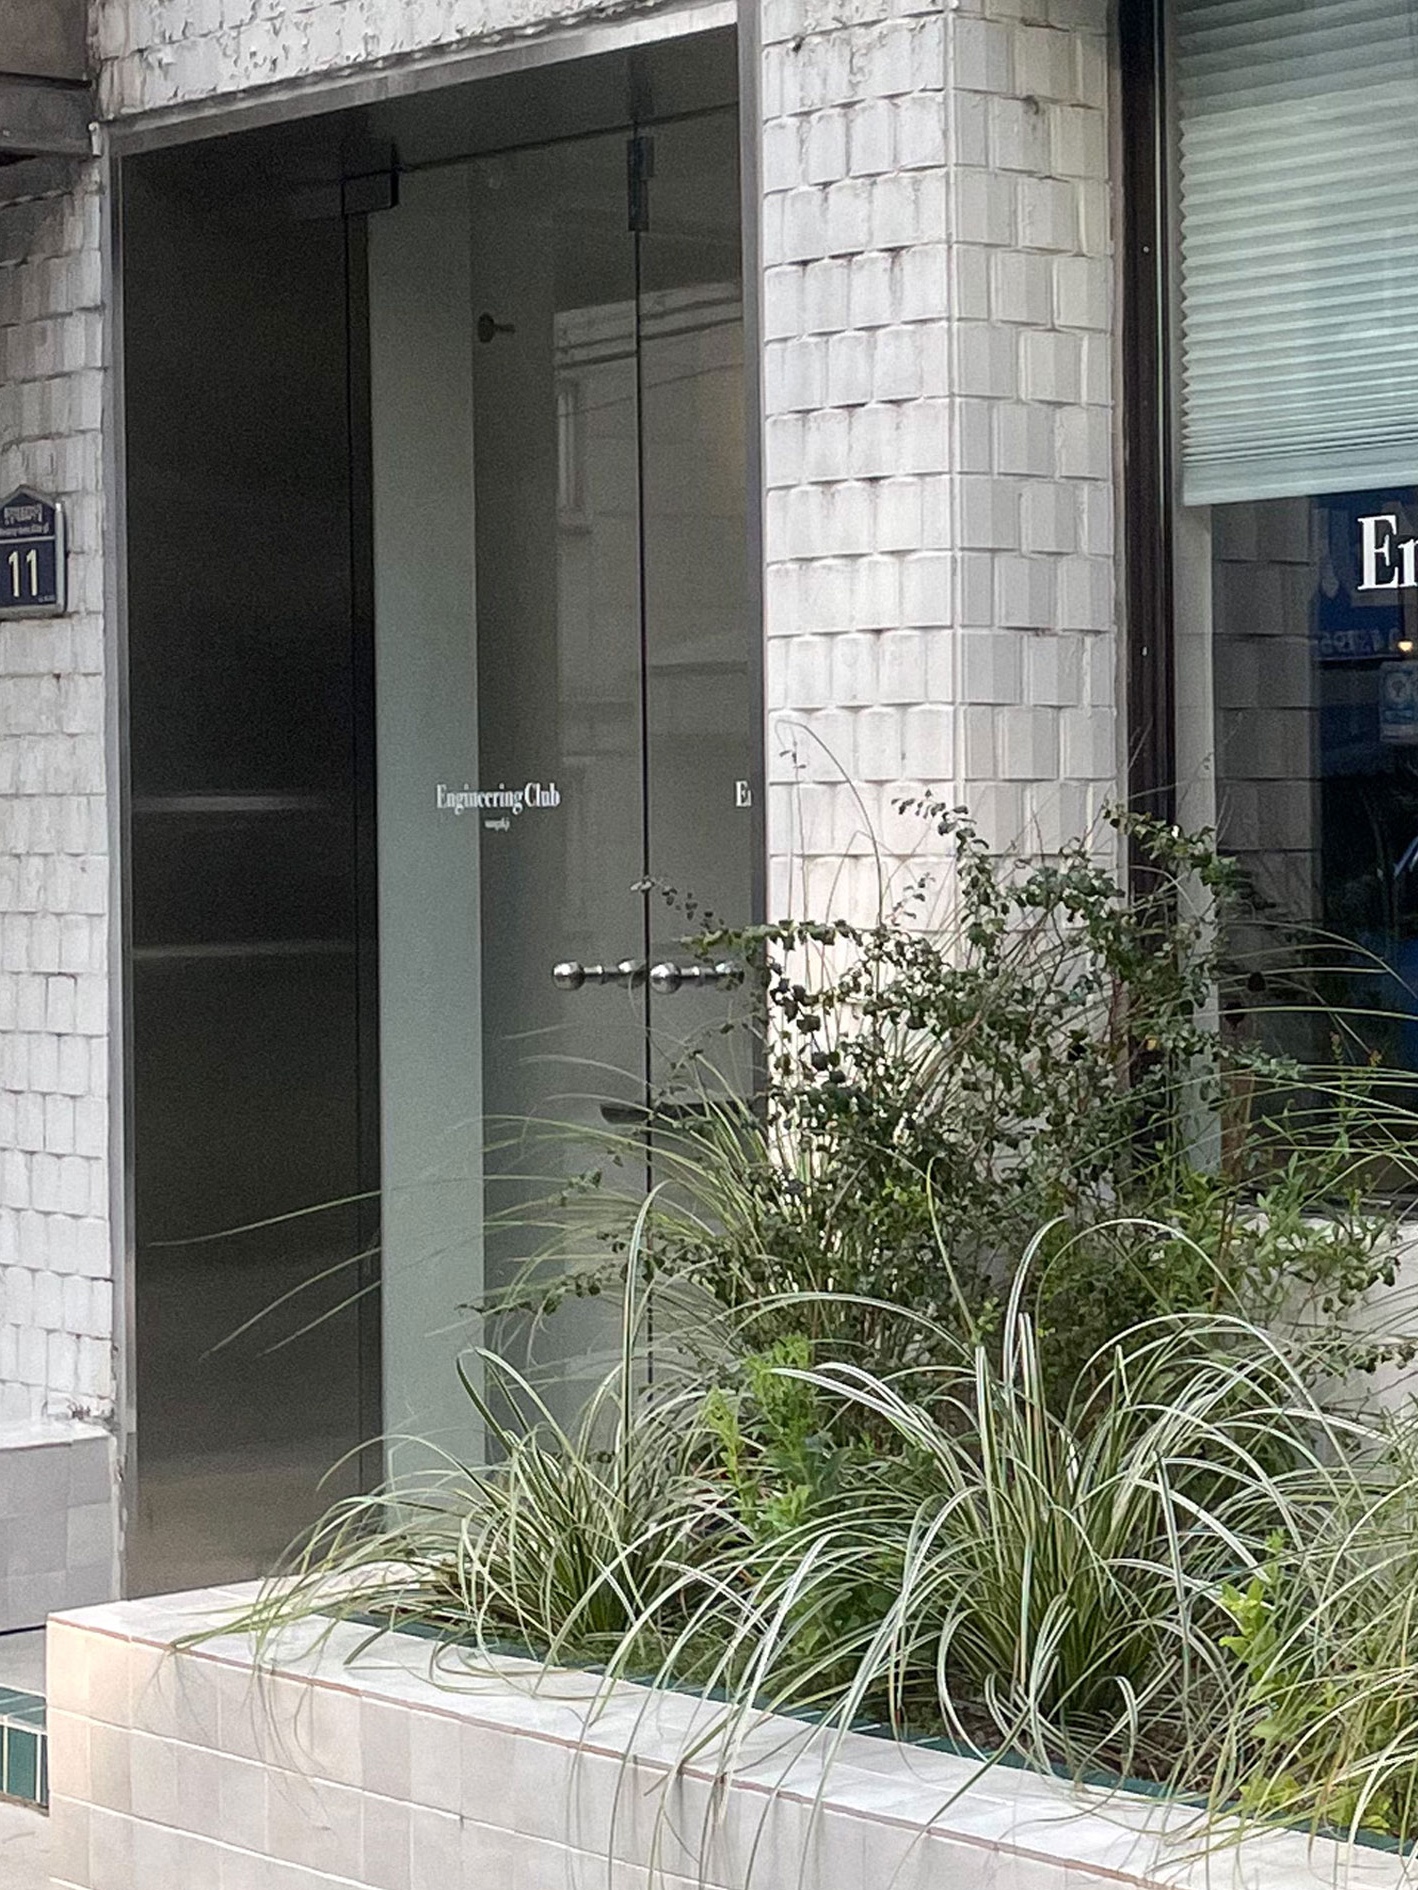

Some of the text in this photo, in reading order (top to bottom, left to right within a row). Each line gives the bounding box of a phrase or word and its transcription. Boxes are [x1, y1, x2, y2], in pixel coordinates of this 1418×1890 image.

[8, 549, 38, 597] 11
[437, 782, 561, 815] Engineering Club
